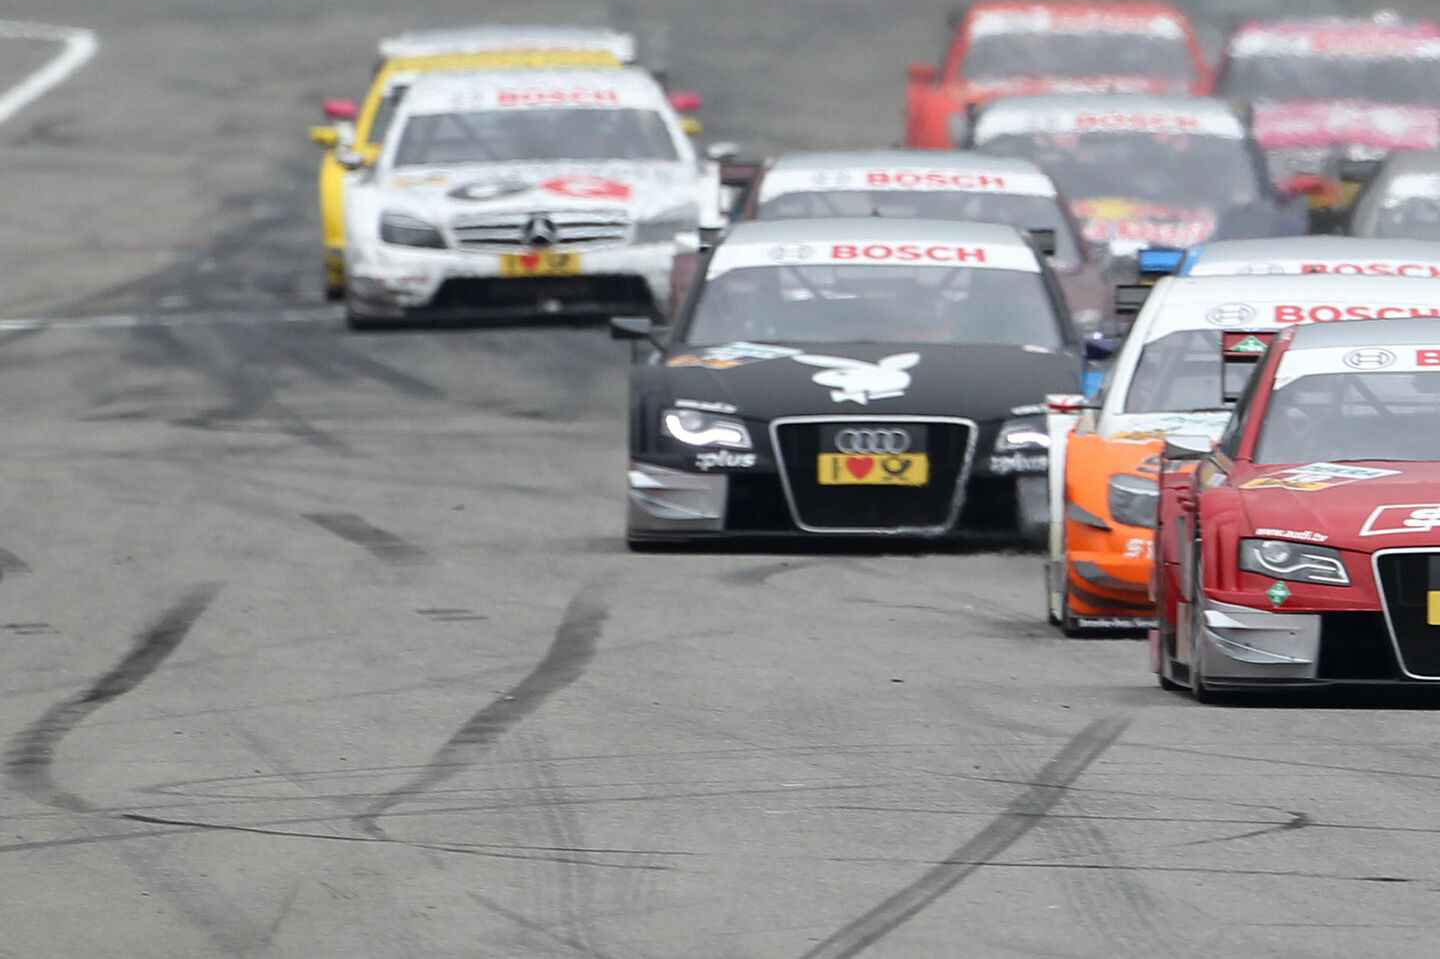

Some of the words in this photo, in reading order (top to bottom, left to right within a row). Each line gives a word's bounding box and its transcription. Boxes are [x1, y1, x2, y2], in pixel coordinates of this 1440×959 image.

[497, 89, 618, 105] BOSCH
[867, 170, 1007, 188] BOSCH
[831, 245, 988, 263] BOSCH
